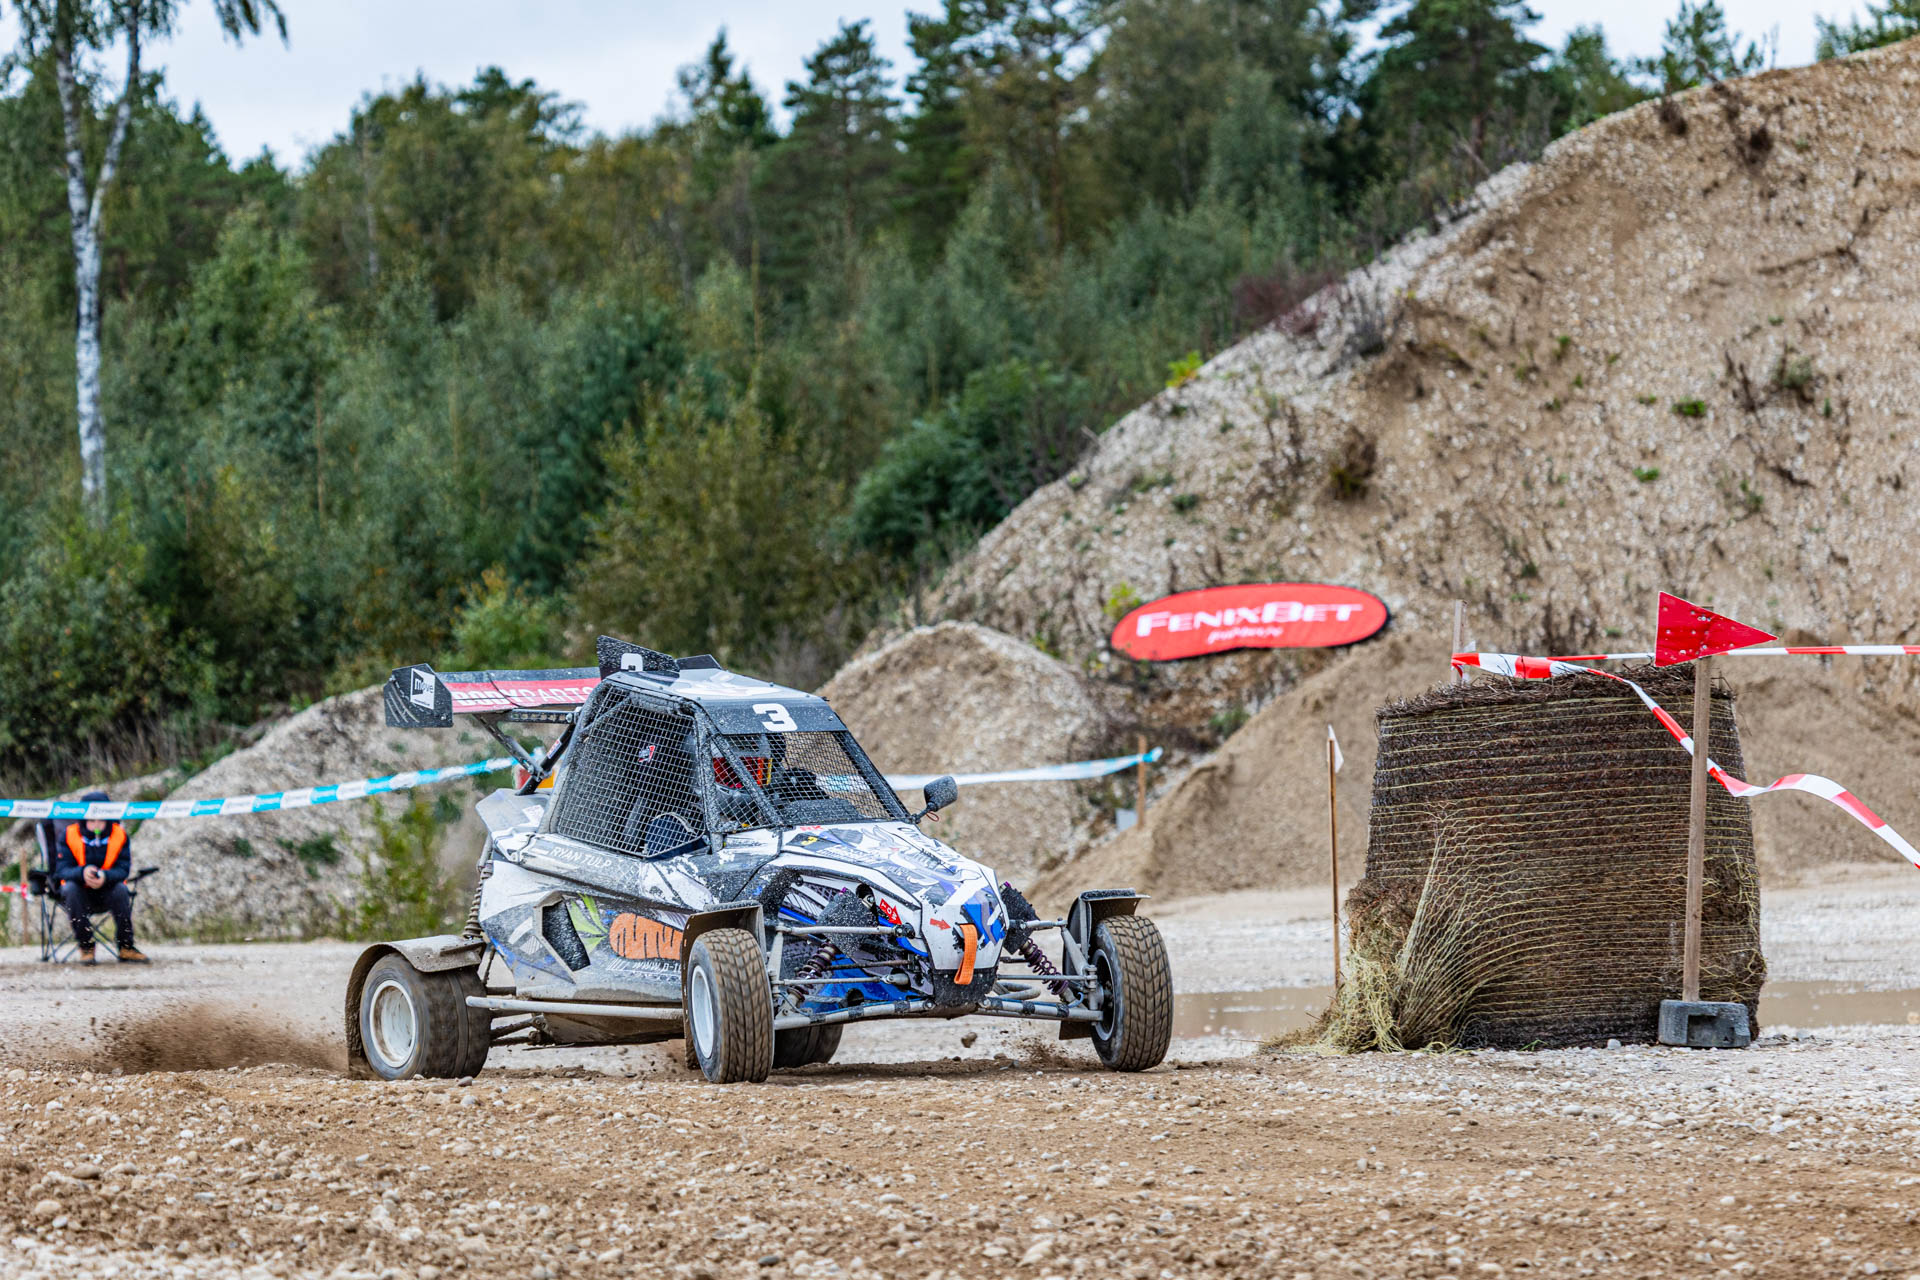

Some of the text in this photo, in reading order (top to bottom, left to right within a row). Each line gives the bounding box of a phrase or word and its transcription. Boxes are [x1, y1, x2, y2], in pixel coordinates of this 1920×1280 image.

[752, 703, 798, 732] 3
[550, 846, 582, 862] RYAN
[882, 903, 898, 921] TOW
